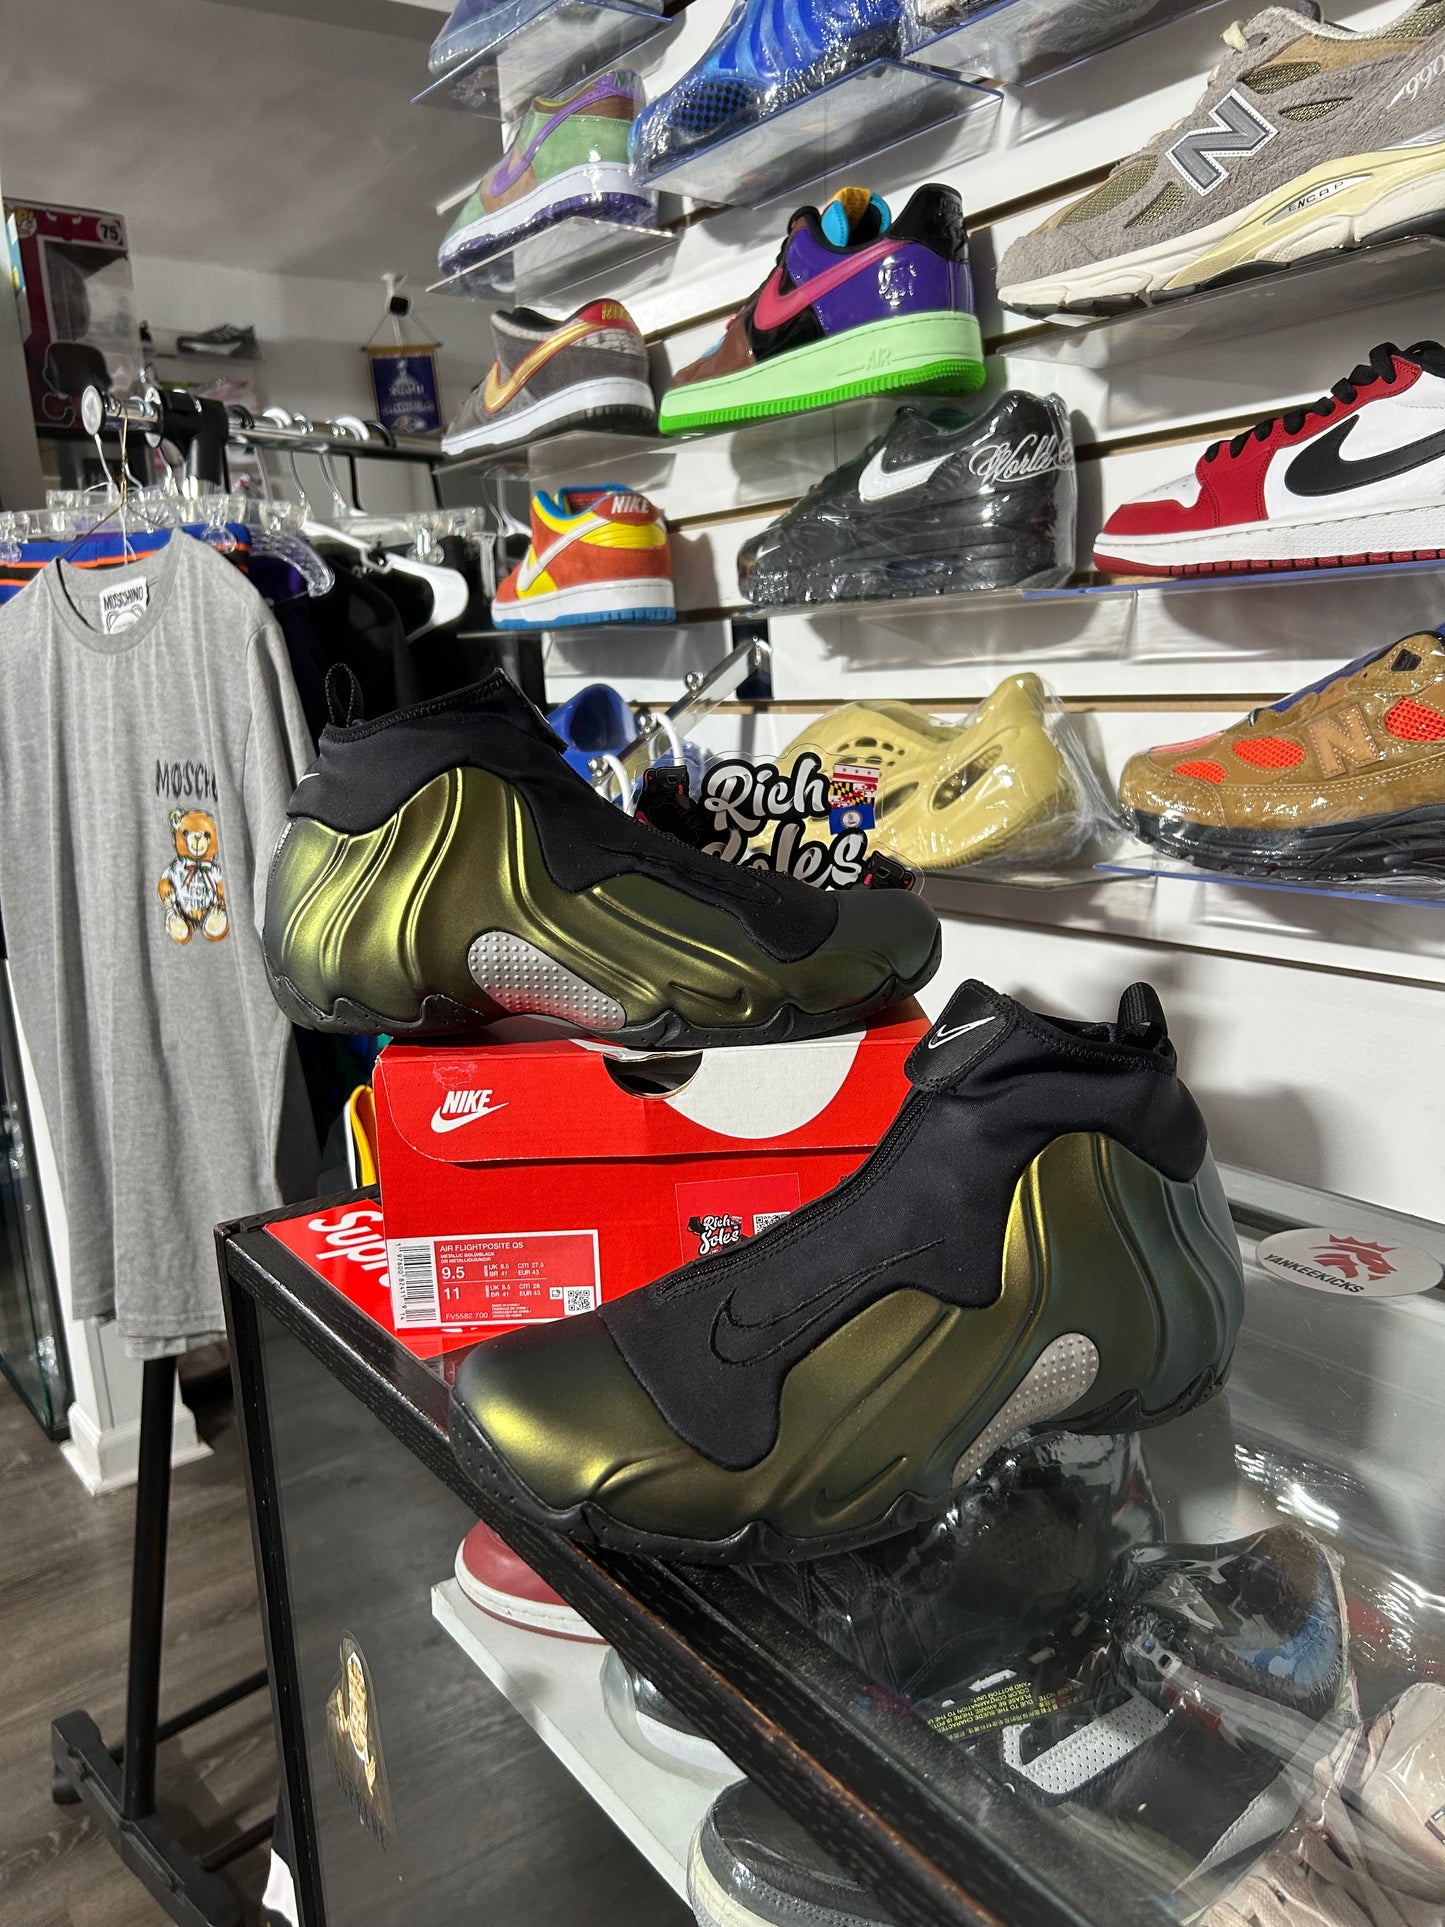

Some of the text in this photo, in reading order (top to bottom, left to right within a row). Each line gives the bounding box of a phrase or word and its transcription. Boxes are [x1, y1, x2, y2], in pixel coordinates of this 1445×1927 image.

[1165, 88, 1278, 196] N
[1288, 181, 1344, 211] ENCAP
[100, 223, 119, 241] 75
[863, 347, 891, 371] AIR
[611, 495, 649, 514] NIKE
[103, 585, 143, 611] MOSCHINO
[702, 755, 828, 833] Rich
[441, 1089, 493, 1114] NIKE
[702, 1214, 732, 1231] Rich
[440, 1244, 454, 1252] AIR
[455, 1242, 510, 1251] FLIGHTPOSITE
[699, 1229, 740, 1255] Soles
[442, 1266, 465, 1279] 9.5
[1263, 1254, 1365, 1293] YANKEEKICKS
[443, 1287, 460, 1300] 11
[987, 1685, 1014, 1698] BOTTOM
[1006, 1686, 1029, 1698] COLOR
[956, 1693, 1007, 1714] CONTAMINATION
[1007, 1692, 1031, 1705] PLEASE
[1019, 1698, 1033, 1707] DUE
[946, 1710, 956, 1718] TO
[974, 1703, 997, 1715] AWARE
[974, 1710, 995, 1721] SUEDE
[996, 1706, 1008, 1714] THE
[934, 1713, 946, 1722] THE
[953, 1711, 974, 1722] THERE
